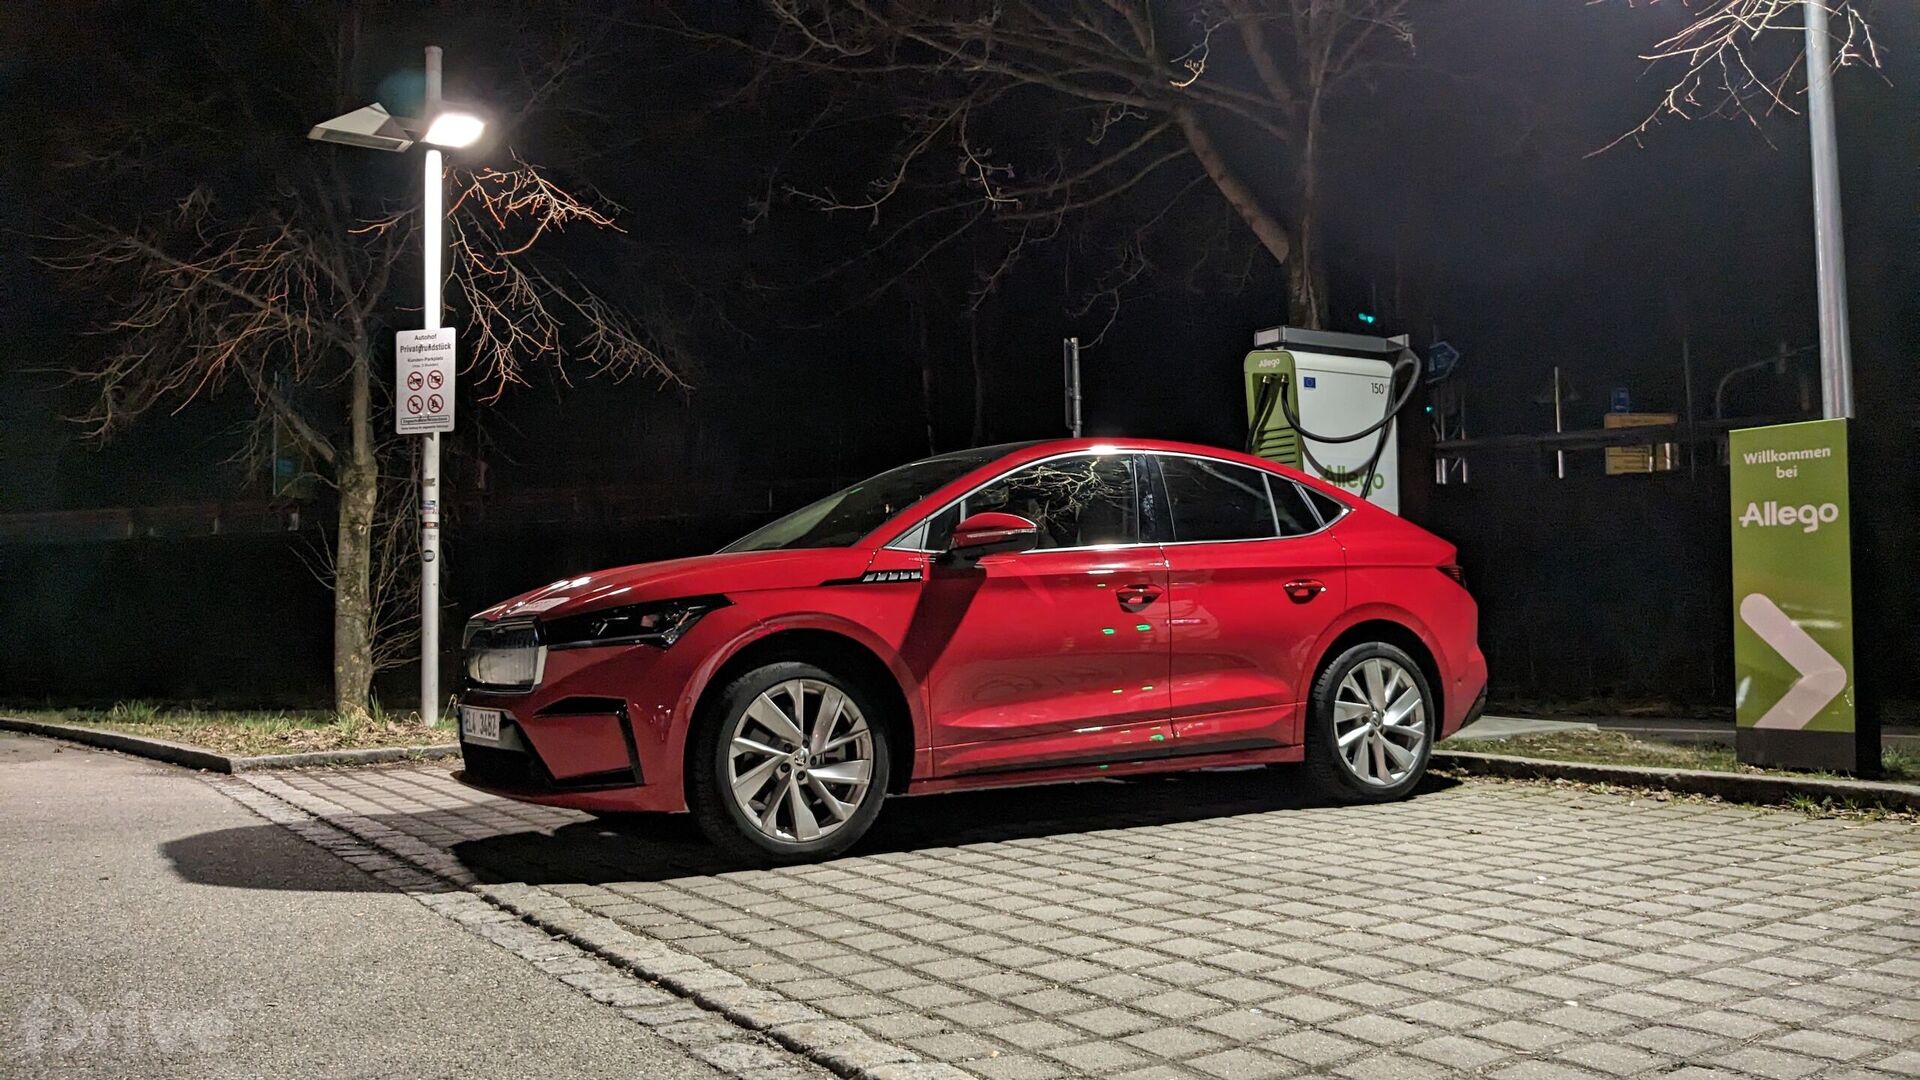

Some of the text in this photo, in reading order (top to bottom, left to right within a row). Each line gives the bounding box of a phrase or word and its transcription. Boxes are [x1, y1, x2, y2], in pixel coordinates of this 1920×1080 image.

[1258, 358, 1280, 368] Allego
[1370, 382, 1385, 395] 150
[1743, 447, 1831, 464] Willkommen
[1775, 465, 1798, 479] bei
[1738, 501, 1839, 533] Allego
